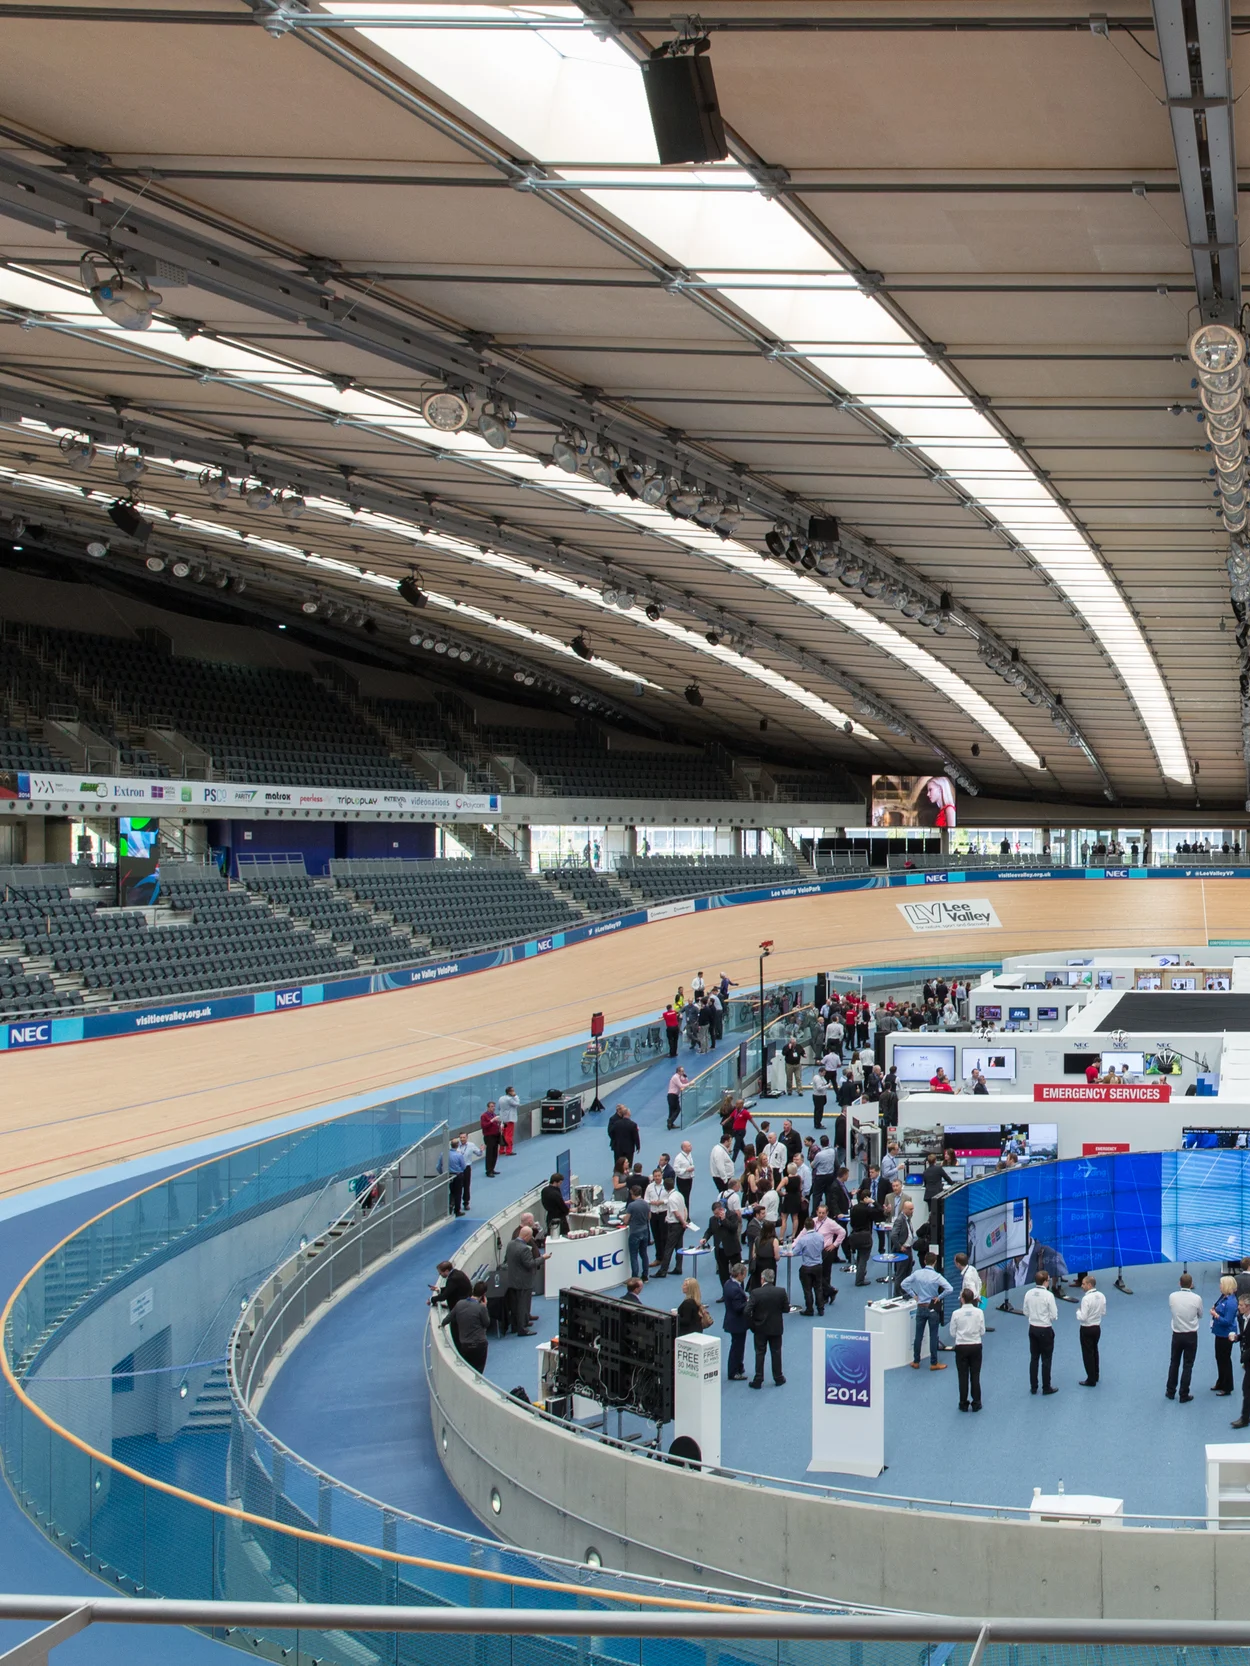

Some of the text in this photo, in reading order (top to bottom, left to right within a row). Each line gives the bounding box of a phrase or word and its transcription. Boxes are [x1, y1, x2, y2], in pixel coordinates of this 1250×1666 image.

[114, 785, 145, 798] Extron
[265, 792, 291, 801] matrox
[411, 797, 450, 806] videonations
[462, 801, 485, 809] Polycom
[926, 874, 947, 882] NEC
[998, 871, 1052, 879] visitleevalley.org.uk
[942, 903, 971, 912] Lee
[947, 911, 990, 922] Valley
[537, 939, 552, 951] NEC
[411, 963, 458, 981] Lee Valley VeloPark
[276, 990, 300, 1006] NEC
[136, 1006, 211, 1026] visitleevalley.org.uk
[11, 1025, 48, 1044] NEC
[1043, 1087, 1160, 1100] EMERGENCY SERVICES
[578, 1249, 624, 1275] NEC
[840, 1334, 869, 1342] SHOWCASE
[677, 1350, 699, 1364] FREE
[703, 1348, 719, 1359] FREE
[677, 1360, 685, 1368] 30
[686, 1363, 699, 1372] MINS
[827, 1387, 868, 1402] 2014
